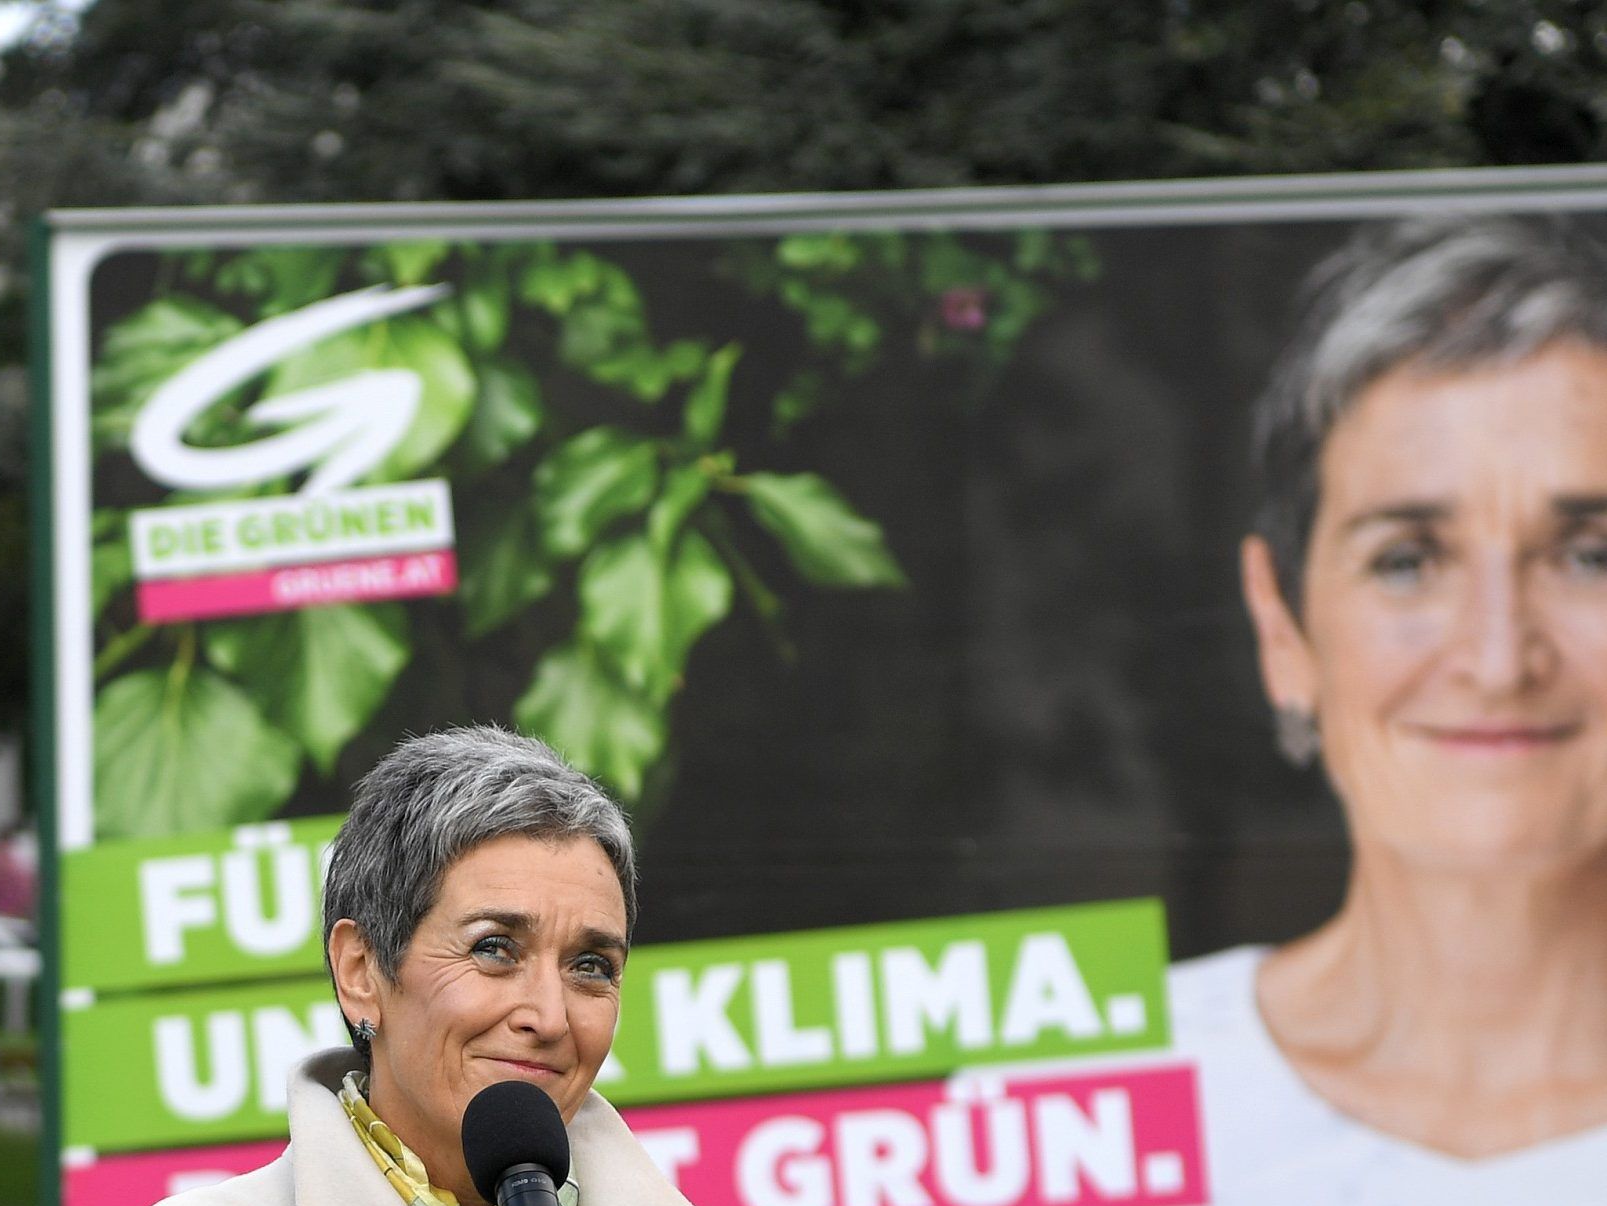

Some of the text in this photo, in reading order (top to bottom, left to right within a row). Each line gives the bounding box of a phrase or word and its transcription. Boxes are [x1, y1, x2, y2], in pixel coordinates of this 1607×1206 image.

[147, 496, 436, 562] DIE GRÜNEN
[138, 820, 330, 966] FÜ
[652, 932, 1148, 1078] KLIMA.
